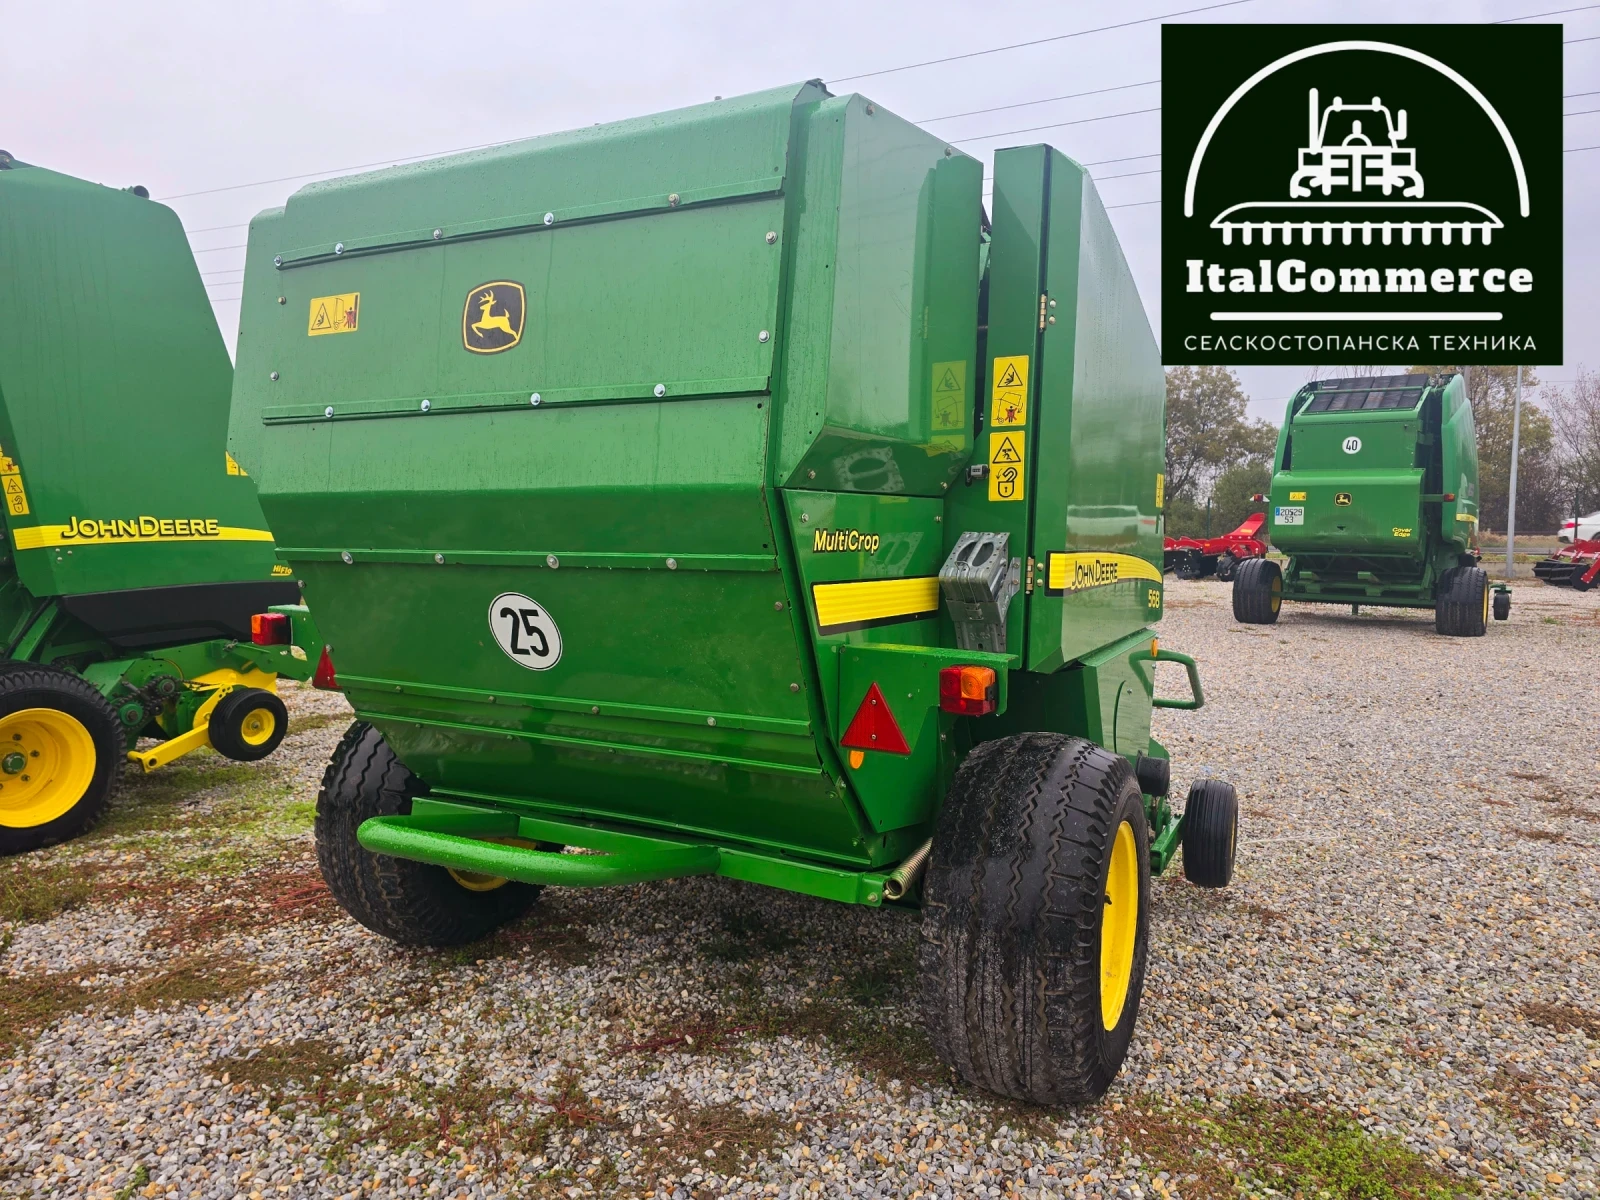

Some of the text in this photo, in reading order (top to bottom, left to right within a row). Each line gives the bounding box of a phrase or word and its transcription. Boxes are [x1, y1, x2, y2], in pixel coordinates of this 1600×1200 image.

[1345, 440, 1358, 451] 40
[61, 516, 220, 537] JOHN DEERE
[1284, 516, 1294, 524] 53
[813, 528, 880, 555] MultiCrop
[1071, 559, 1118, 589] JOHN DEERE
[1148, 589, 1160, 608] 568
[500, 607, 550, 657] 25
